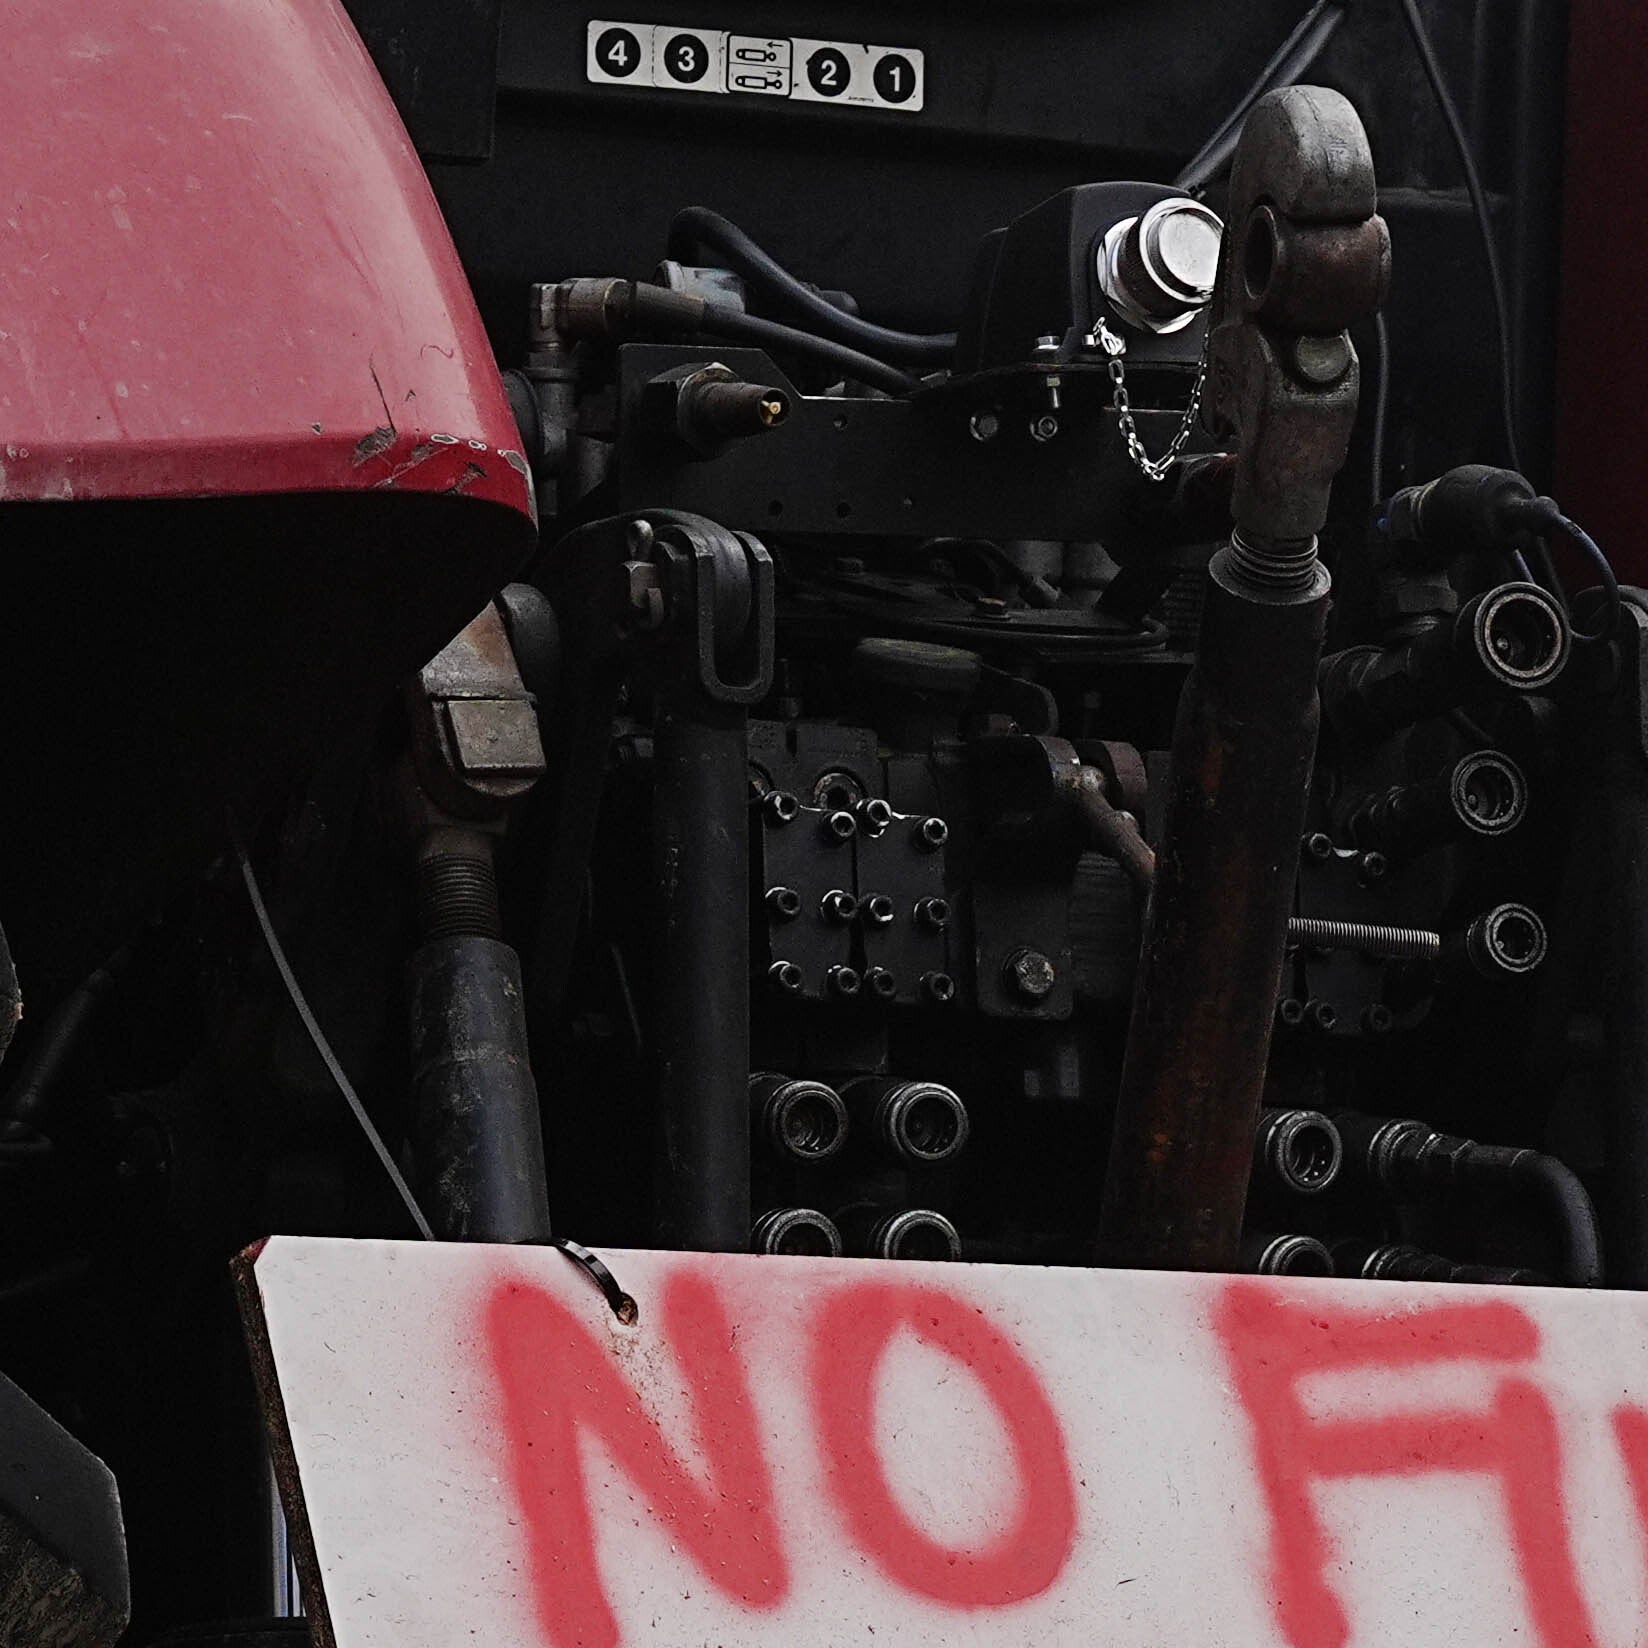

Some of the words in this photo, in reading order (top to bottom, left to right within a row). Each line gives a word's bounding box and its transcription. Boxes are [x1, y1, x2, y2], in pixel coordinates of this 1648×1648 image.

[607, 40, 628, 66] 4
[677, 46, 696, 72] 3
[820, 60, 838, 86] 2
[888, 67, 901, 92] 1
